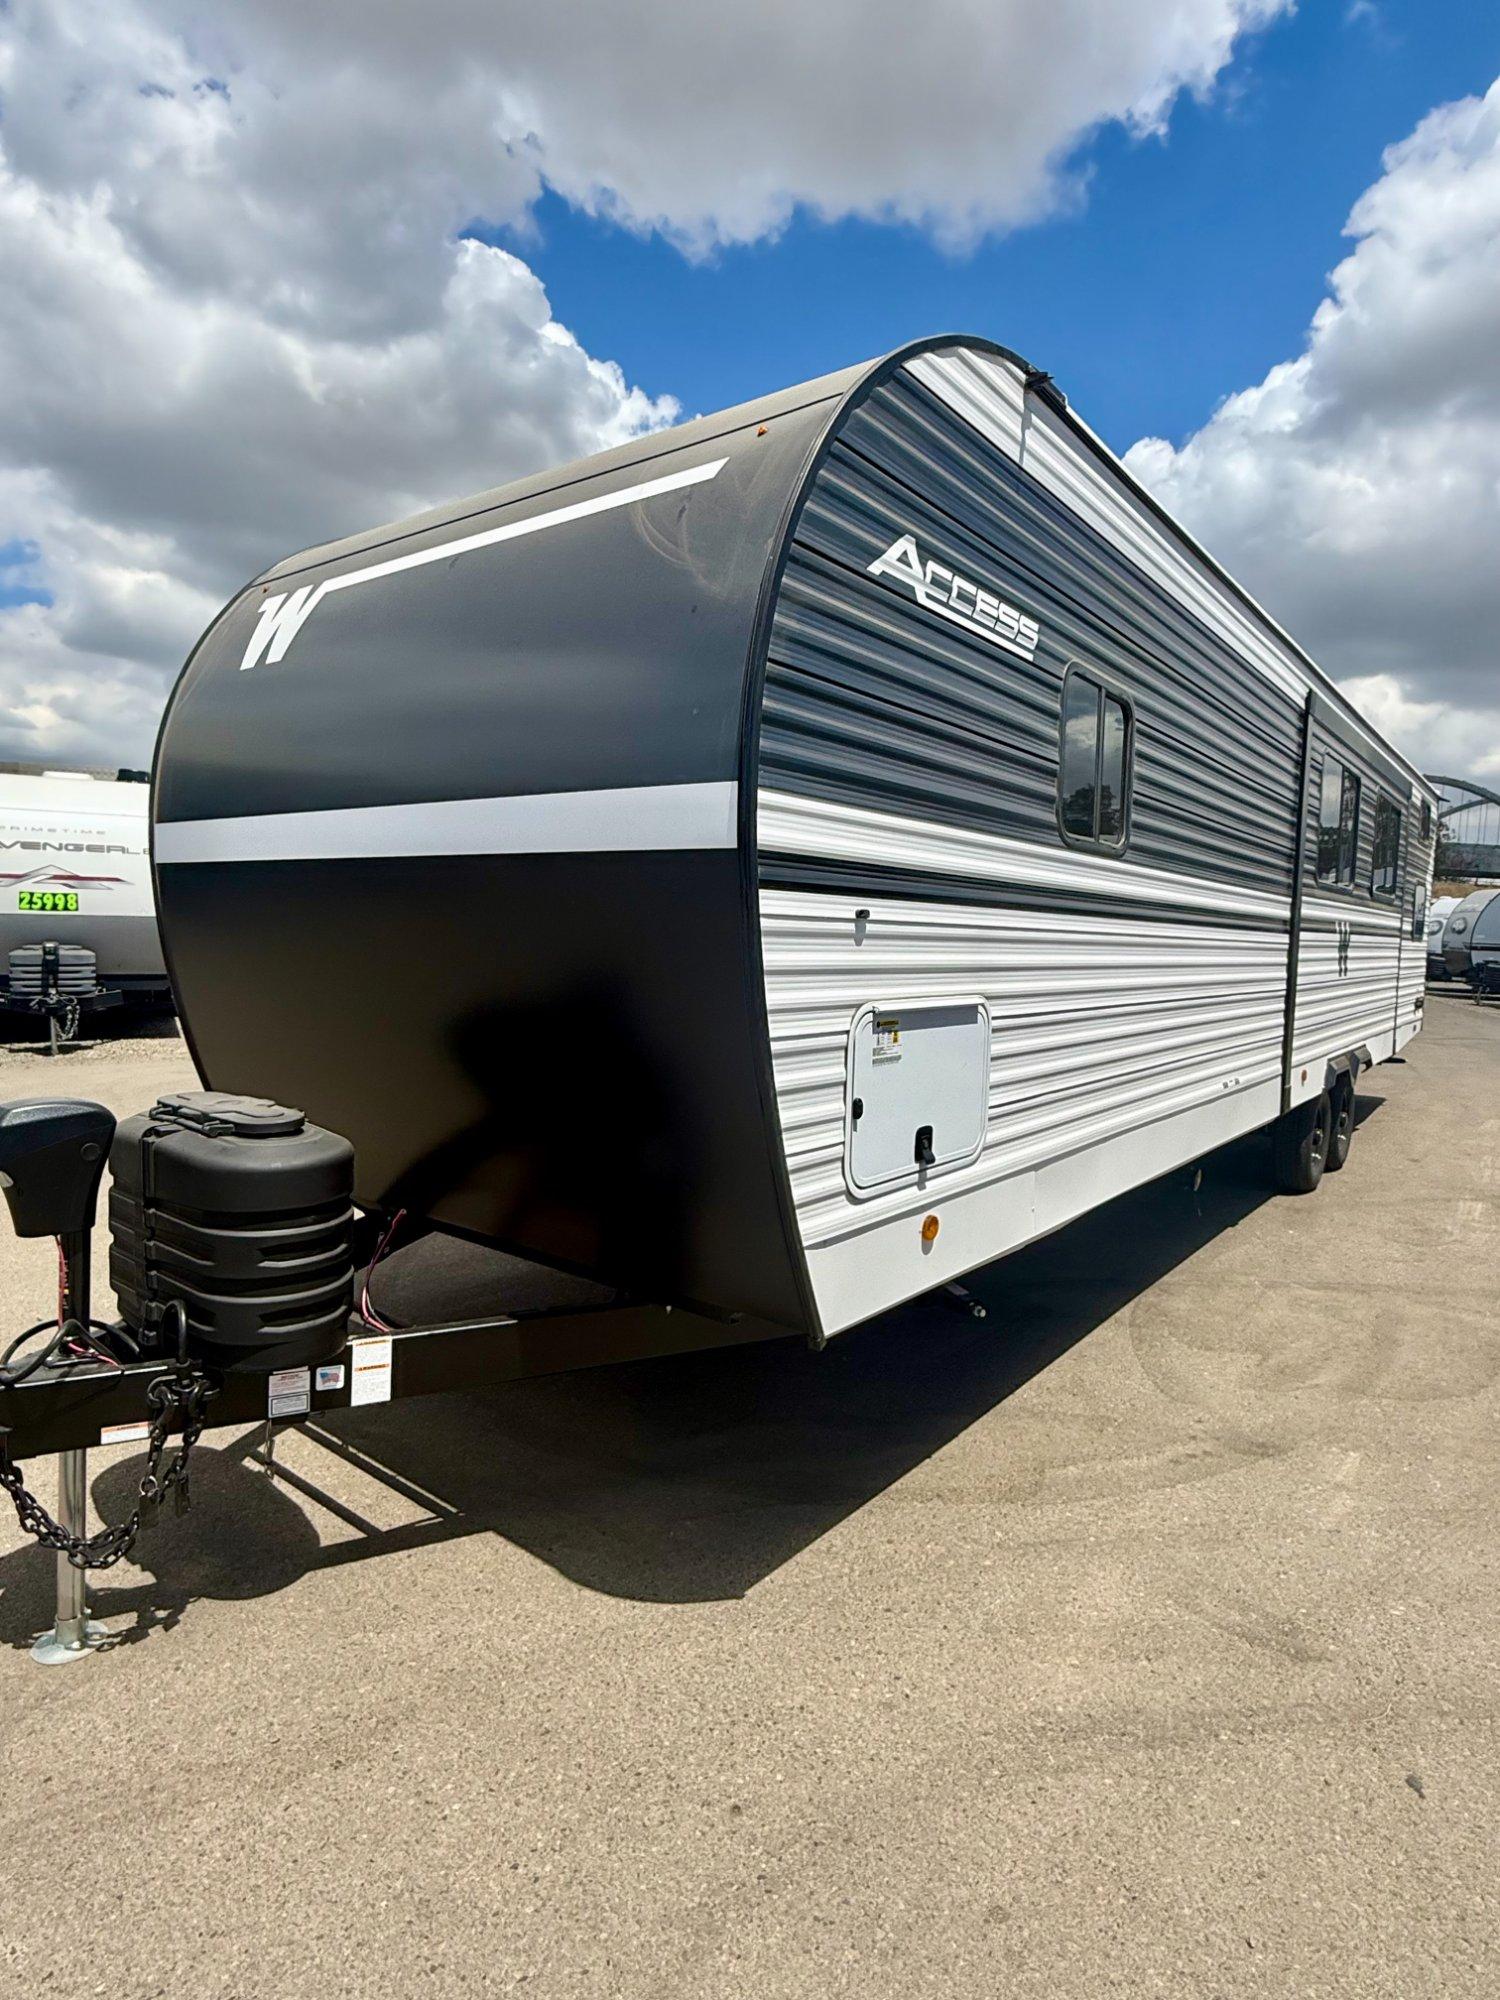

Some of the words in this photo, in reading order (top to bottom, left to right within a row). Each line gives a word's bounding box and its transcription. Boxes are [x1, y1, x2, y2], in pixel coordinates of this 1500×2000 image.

[866, 533, 1040, 653] ACCESS
[239, 580, 328, 671] W
[0, 840, 126, 854] VENGER
[20, 892, 78, 911] 25998
